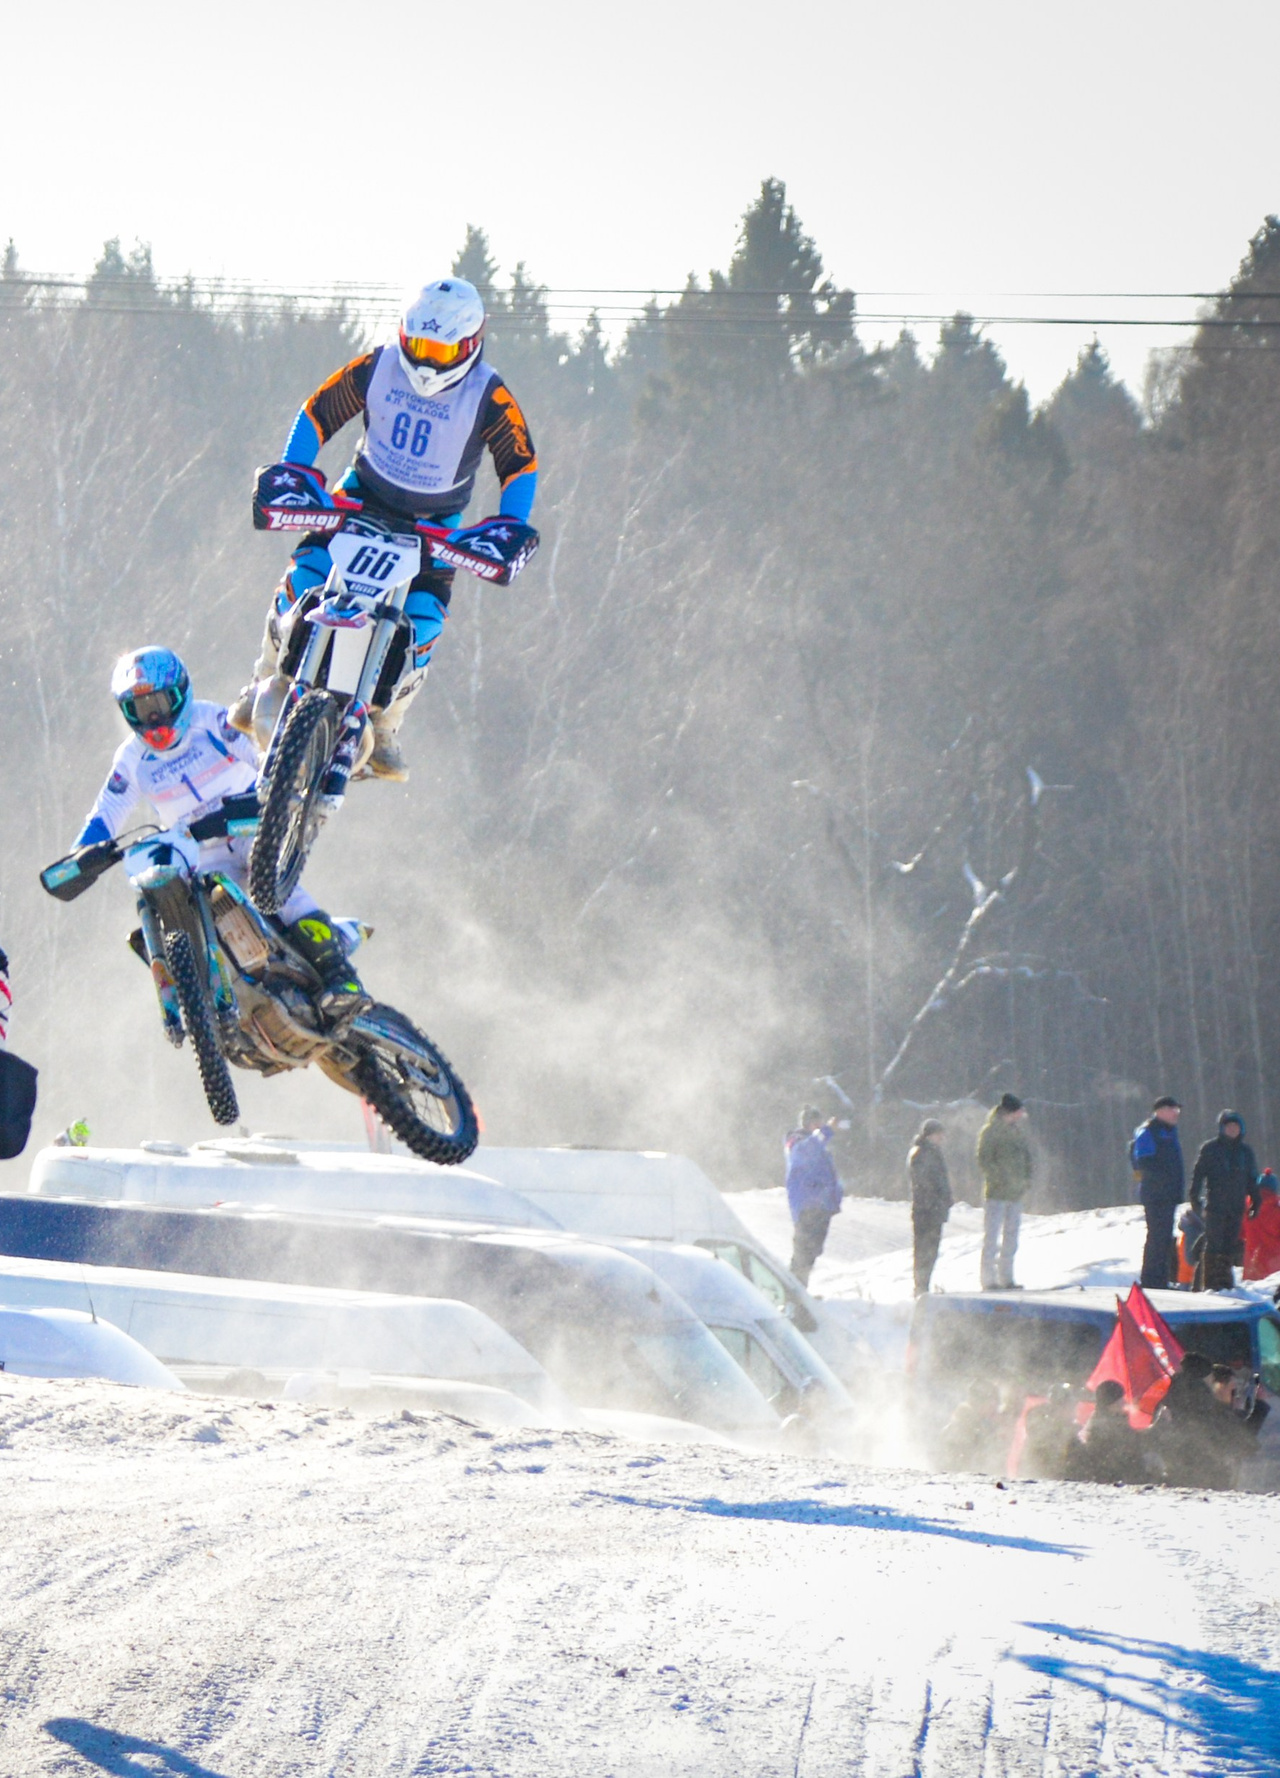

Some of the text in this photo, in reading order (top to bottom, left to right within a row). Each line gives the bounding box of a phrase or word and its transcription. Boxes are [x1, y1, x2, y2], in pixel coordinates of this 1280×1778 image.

[391, 412, 432, 458] 66
[346, 545, 401, 581] 66
[180, 773, 203, 802] 1
